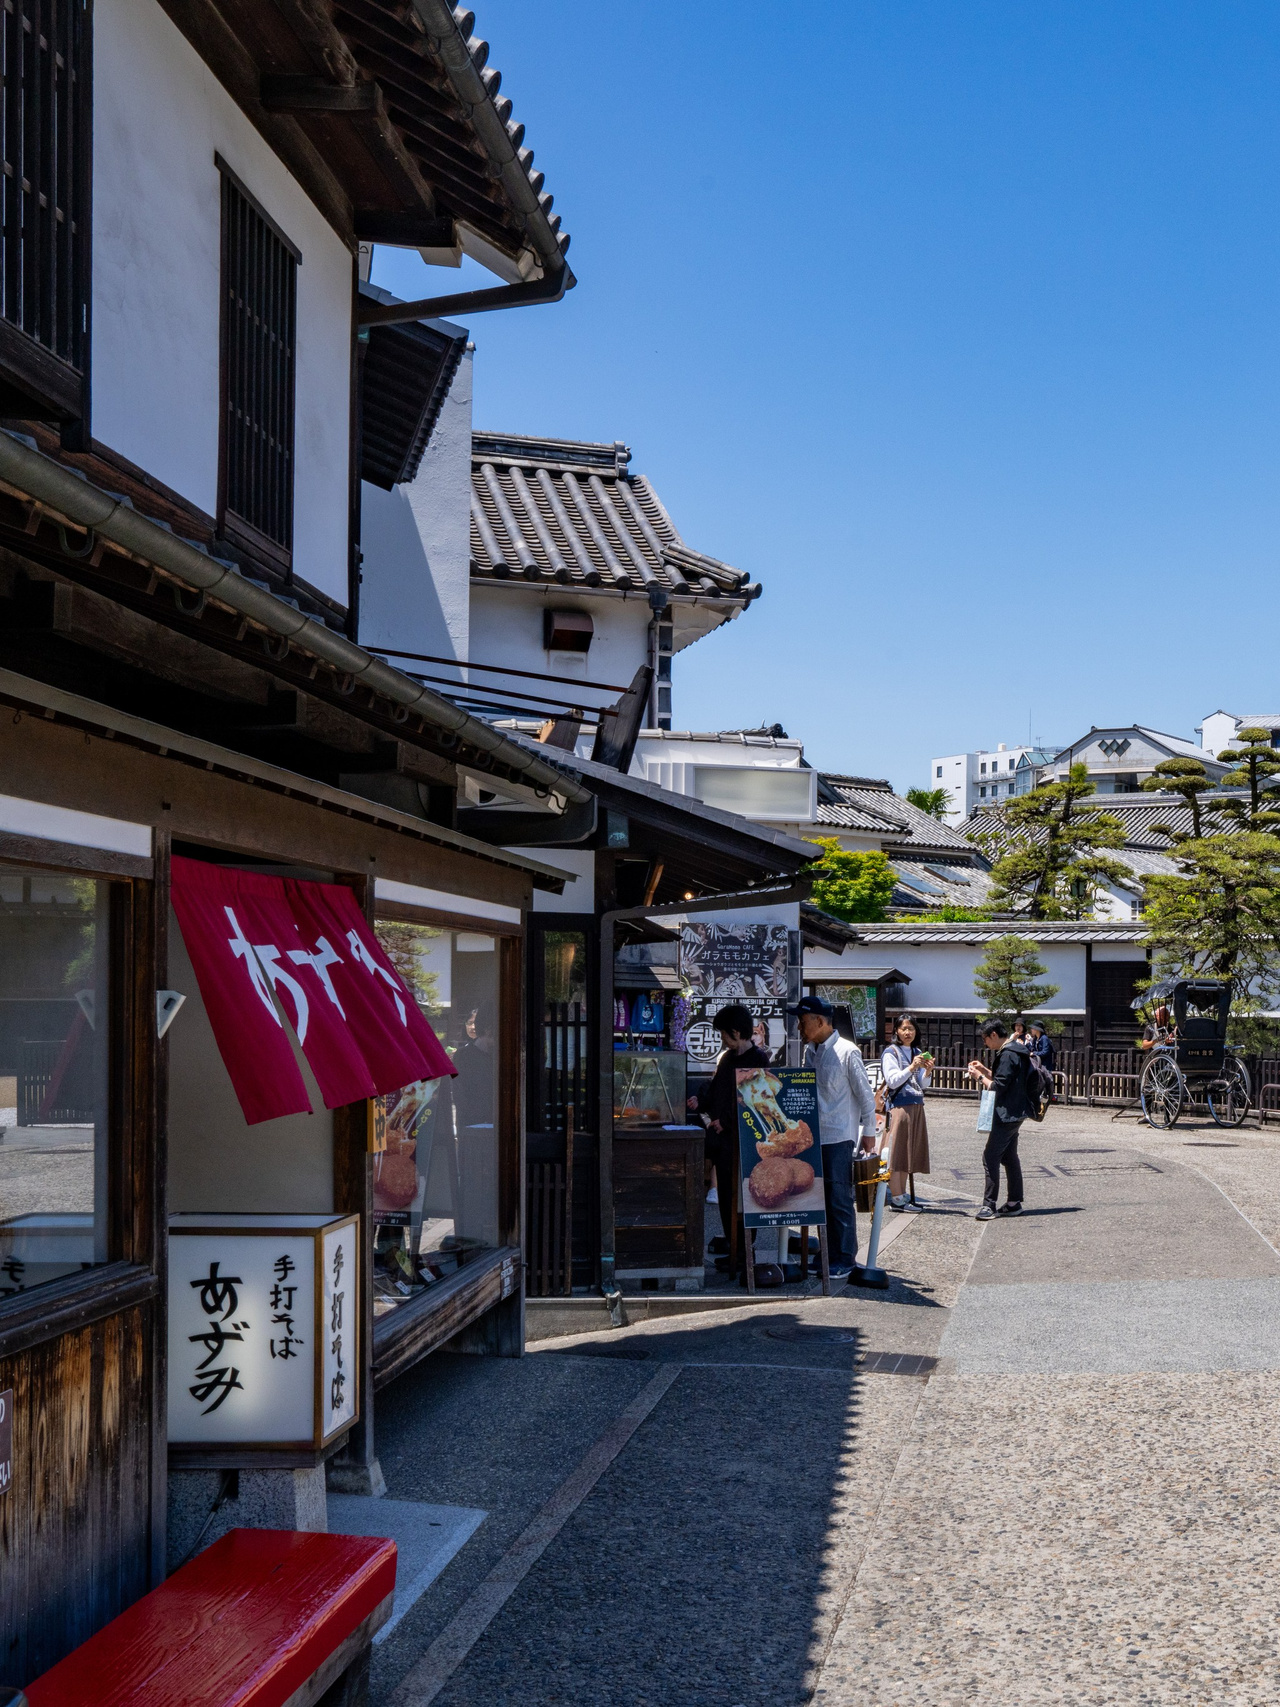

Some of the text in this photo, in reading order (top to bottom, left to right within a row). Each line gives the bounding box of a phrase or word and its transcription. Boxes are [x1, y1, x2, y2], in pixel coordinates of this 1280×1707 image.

[701, 950, 770, 961] ガラモモカフェ
[705, 1003, 783, 1016] 倉カフェ
[188, 1262, 250, 1415] あずみ
[270, 1254, 304, 1360] 手打そば
[331, 1245, 346, 1411] 手打そば
